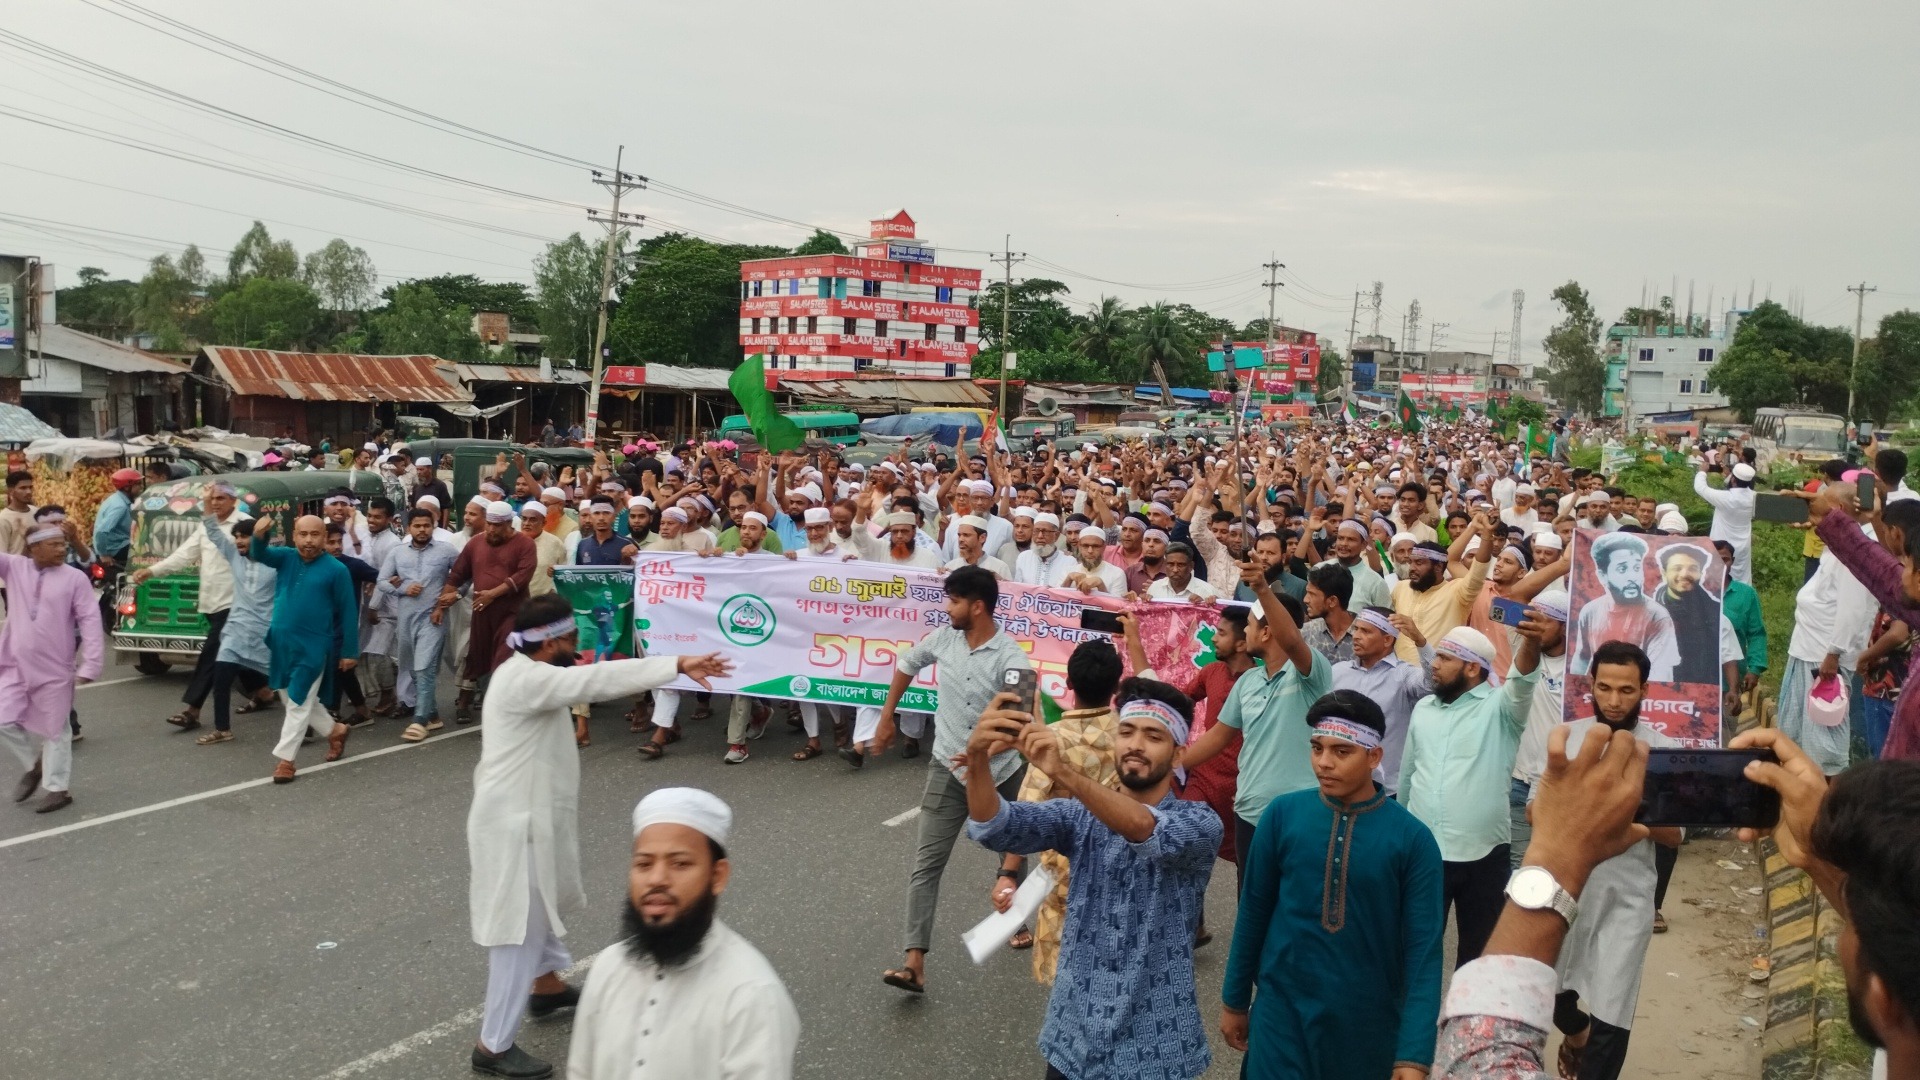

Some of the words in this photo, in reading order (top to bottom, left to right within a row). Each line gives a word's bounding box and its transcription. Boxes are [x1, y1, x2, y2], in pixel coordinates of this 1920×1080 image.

[888, 223, 914, 234] SCRM
[836, 267, 863, 277] SCRM
[870, 270, 897, 280] SCRM
[919, 275, 945, 284] SCRM
[952, 278, 977, 287] SCRM
[840, 299, 873, 311] SALAM
[944, 308, 970, 319] STEEL
[839, 334, 872, 345] SALAM
[943, 341, 968, 351] STEEL
[260, 499, 290, 512] 2024
[556, 570, 584, 584] শহীদ
[586, 572, 609, 585] আবু
[639, 574, 708, 605] জুলাই
[846, 574, 909, 603] জুলাই
[815, 682, 868, 700] বাংলাদেশ
